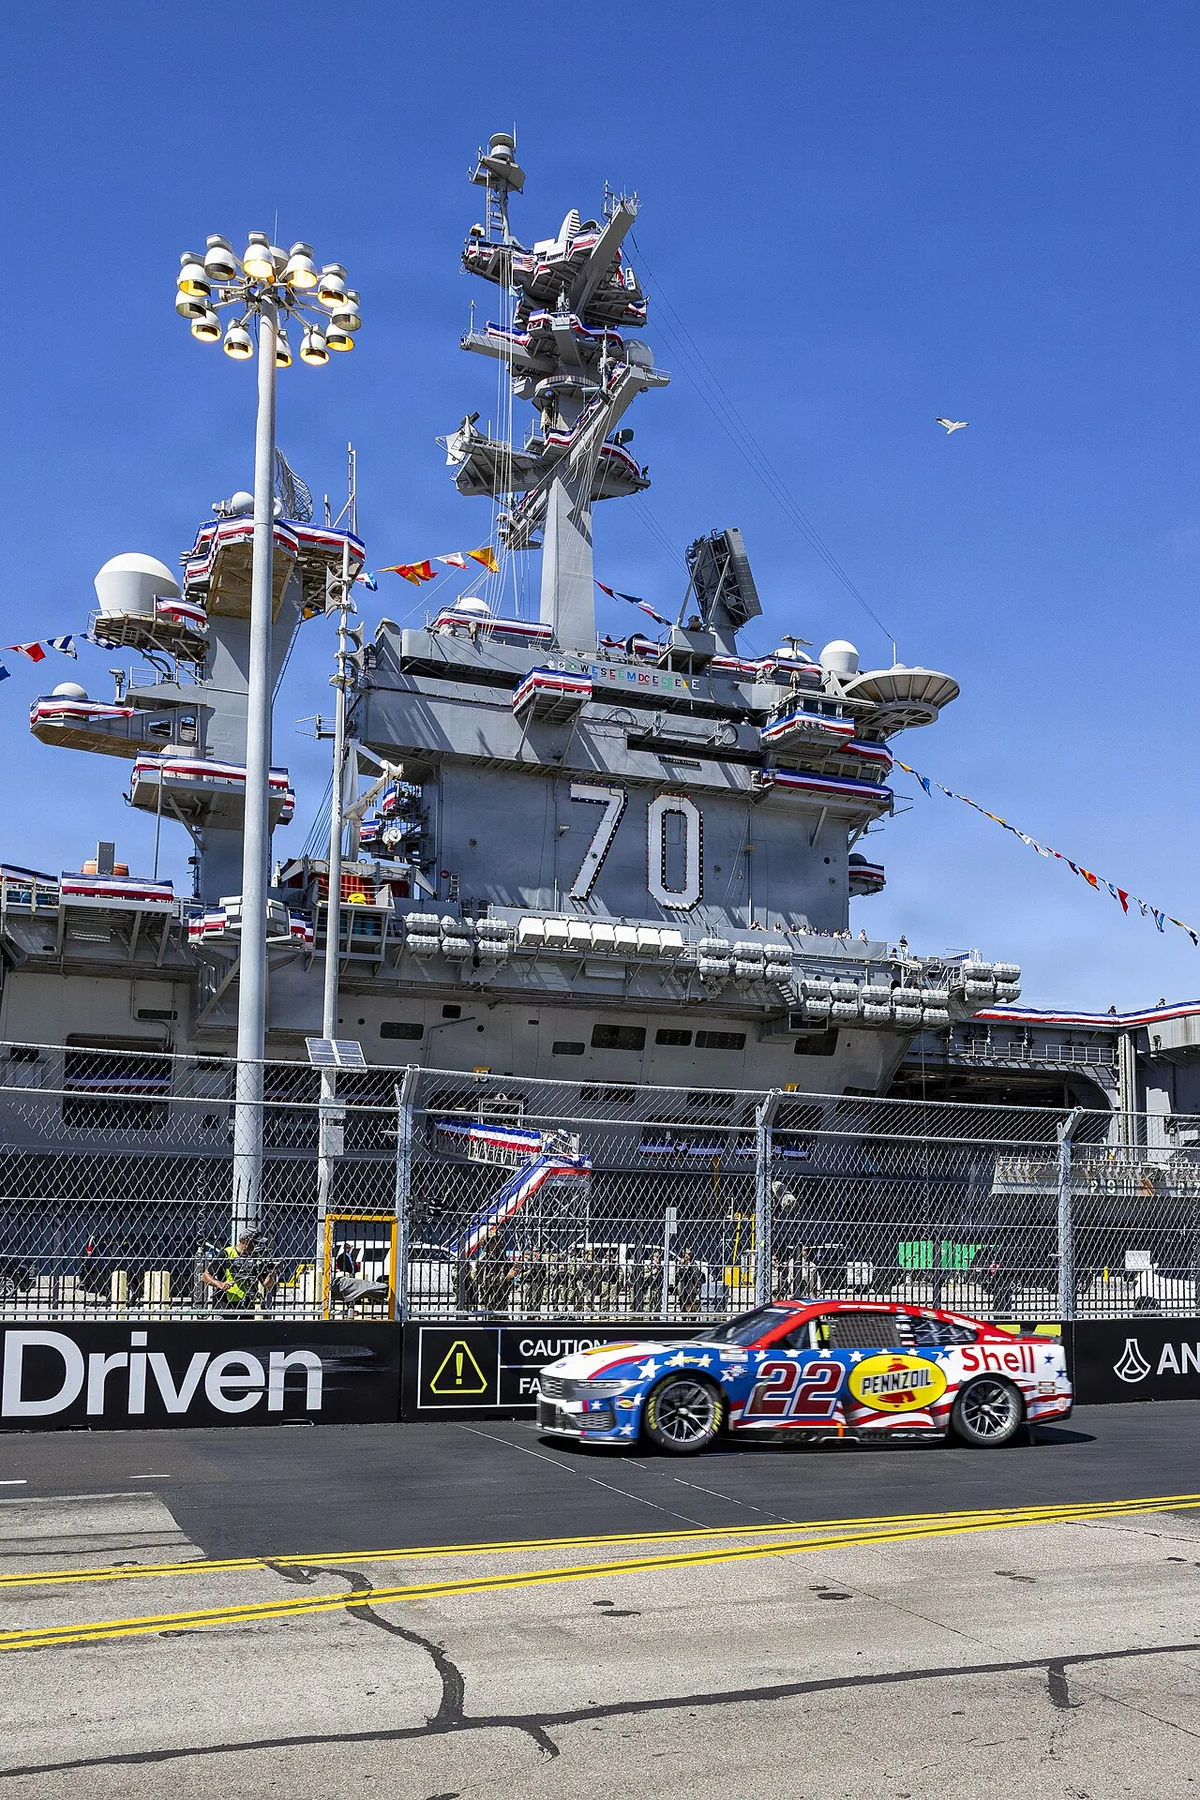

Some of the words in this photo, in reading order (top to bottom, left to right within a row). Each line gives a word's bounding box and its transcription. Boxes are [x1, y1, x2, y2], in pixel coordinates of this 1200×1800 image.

[569, 782, 705, 912] 70
[1, 1330, 323, 1417] Driven
[960, 1345, 1036, 1374] Shell
[1156, 1342, 1200, 1375] AN
[742, 1360, 846, 1417] 22
[861, 1367, 933, 1397] PENNZOIL
